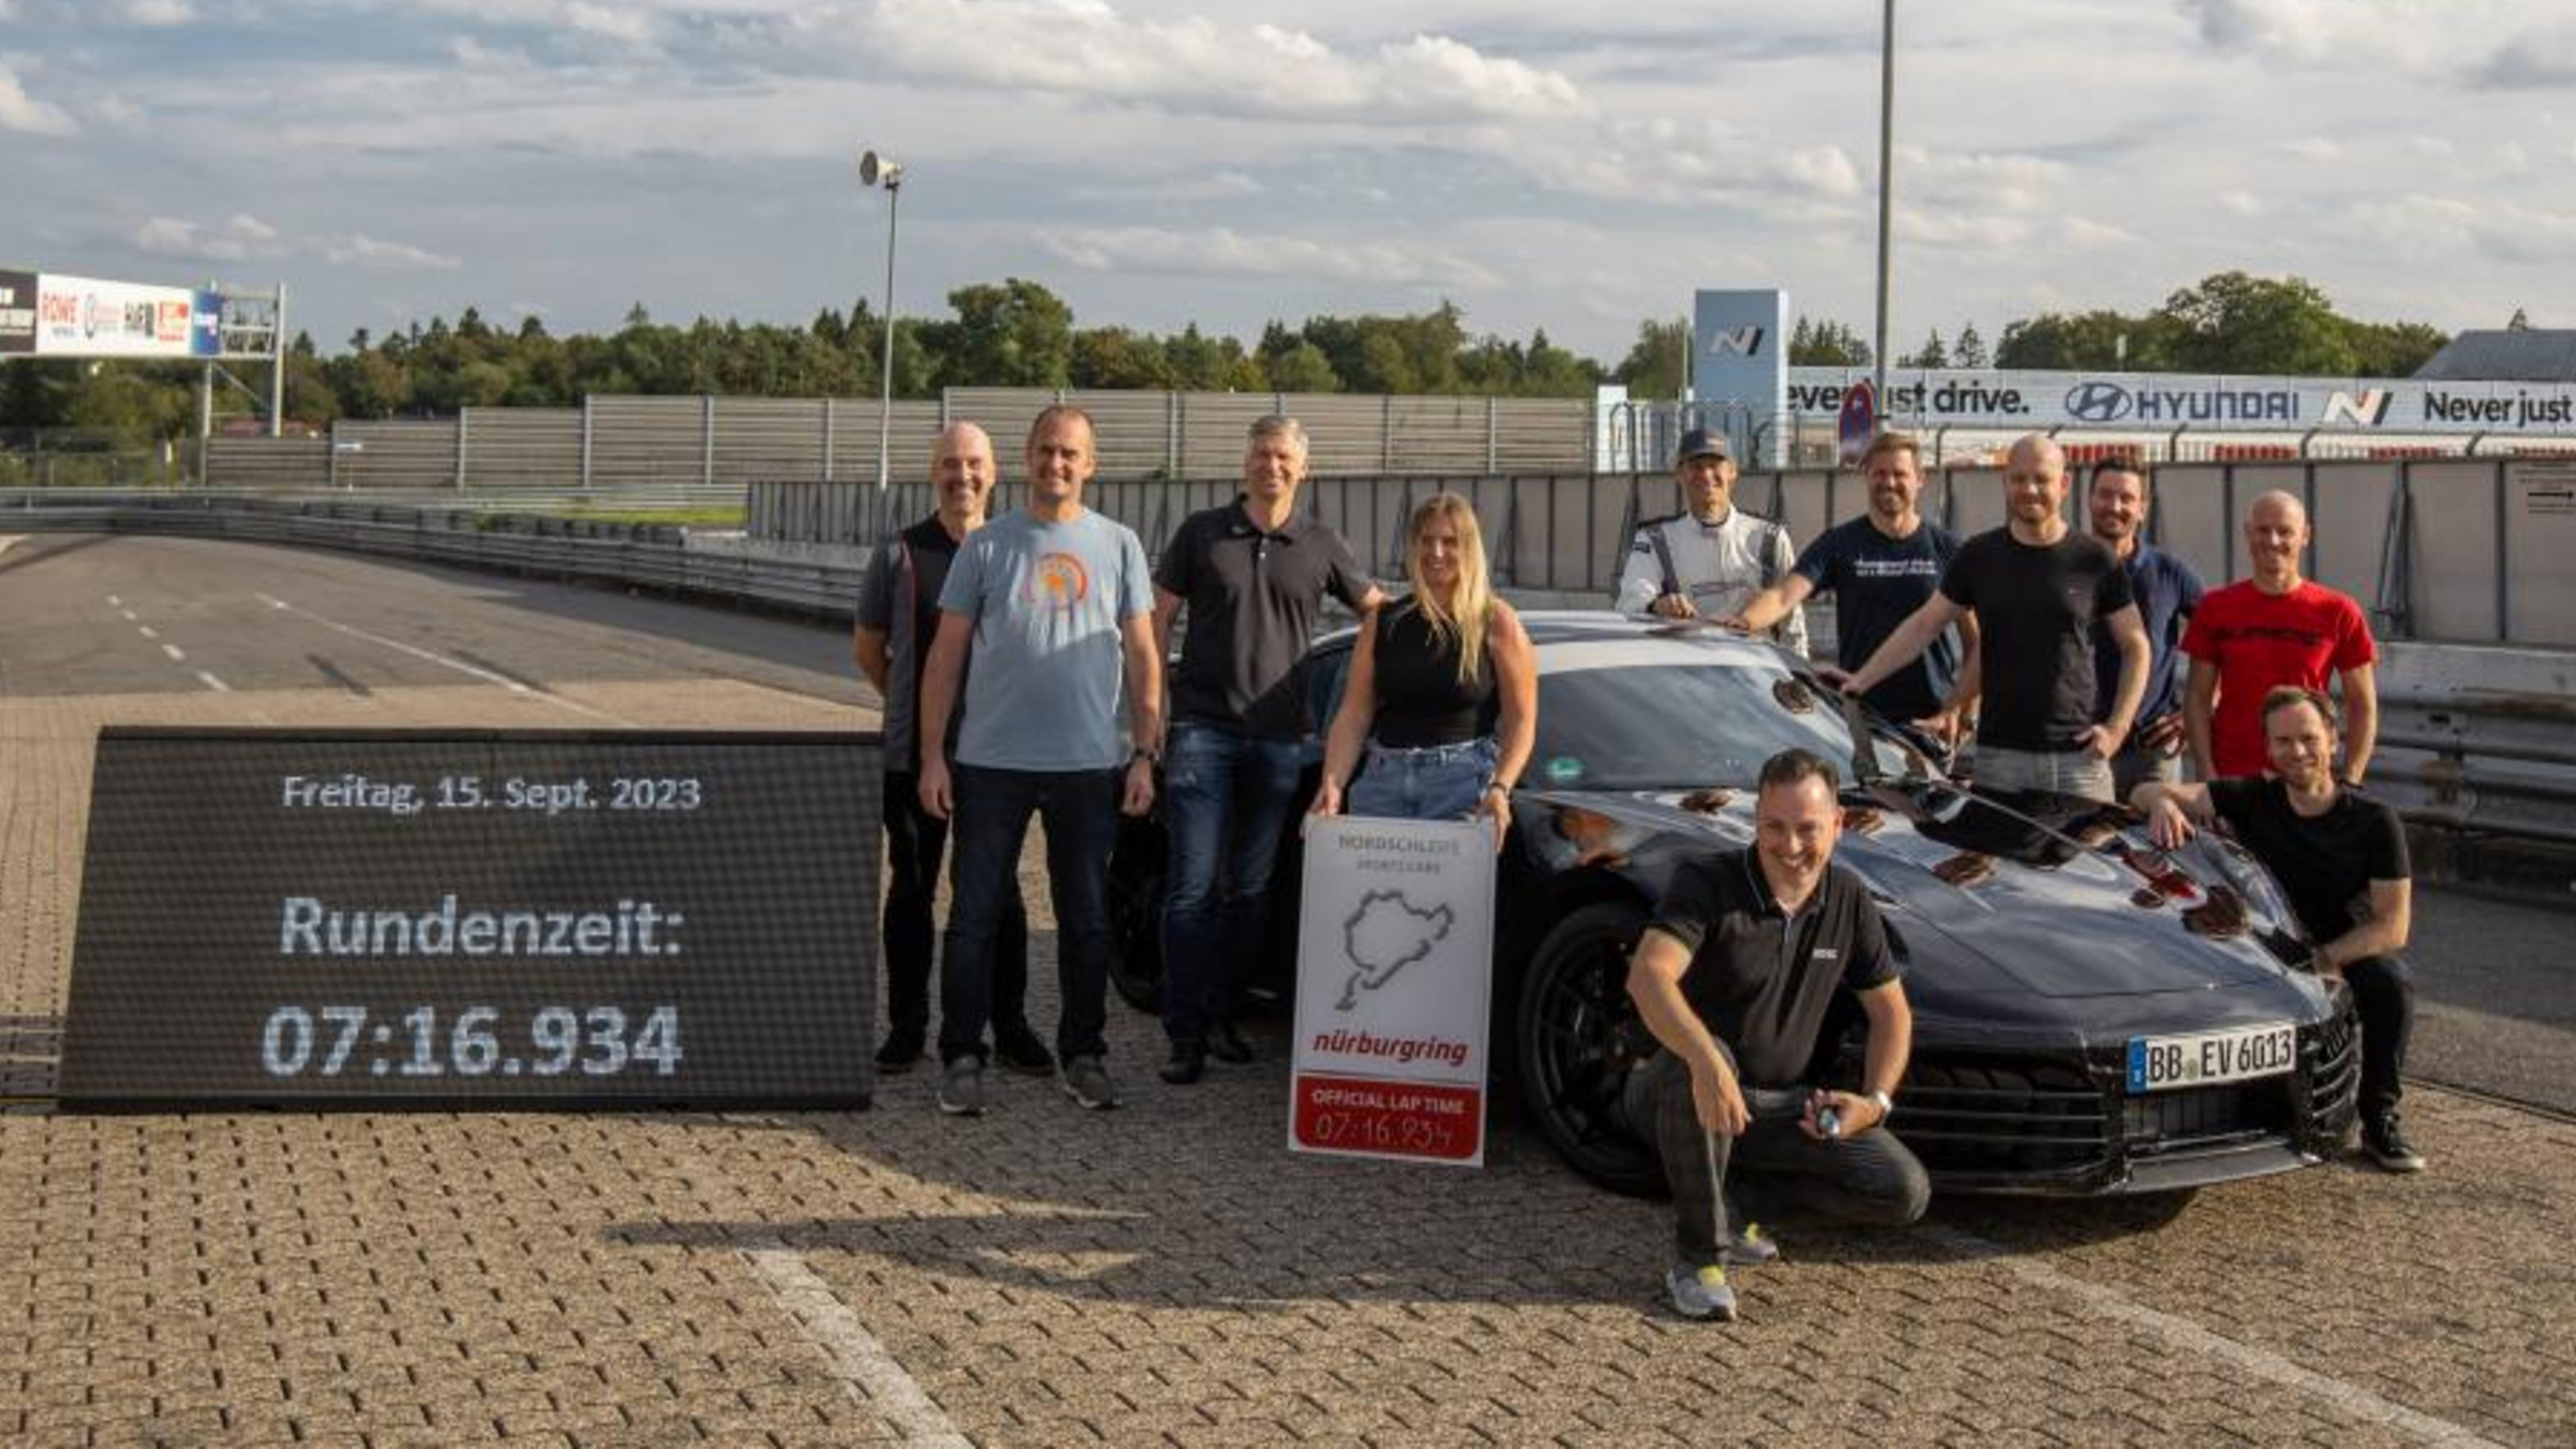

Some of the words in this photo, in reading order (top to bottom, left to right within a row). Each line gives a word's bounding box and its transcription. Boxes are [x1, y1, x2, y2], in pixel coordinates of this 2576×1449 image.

[1934, 381, 2030, 413] drive.
[2137, 391, 2298, 419] HYUNDAI
[2425, 391, 2512, 422] Never
[2517, 390, 2573, 428] just
[283, 774, 424, 815] Freitag,
[437, 776, 489, 807] 15.
[506, 778, 597, 815] Sept.
[610, 778, 701, 808] 2023
[280, 894, 684, 955] Rundenzeit:
[262, 1005, 683, 1075] 07:16.934
[1314, 1029, 1468, 1067] nürburgring
[2149, 1046, 2182, 1082] BB
[2200, 1038, 2234, 1077] EV
[2237, 1030, 2293, 1072] 6013
[1312, 1089, 1385, 1108] OFFICIAL
[1390, 1094, 1421, 1111] LAP
[1425, 1097, 1464, 1113] TIME
